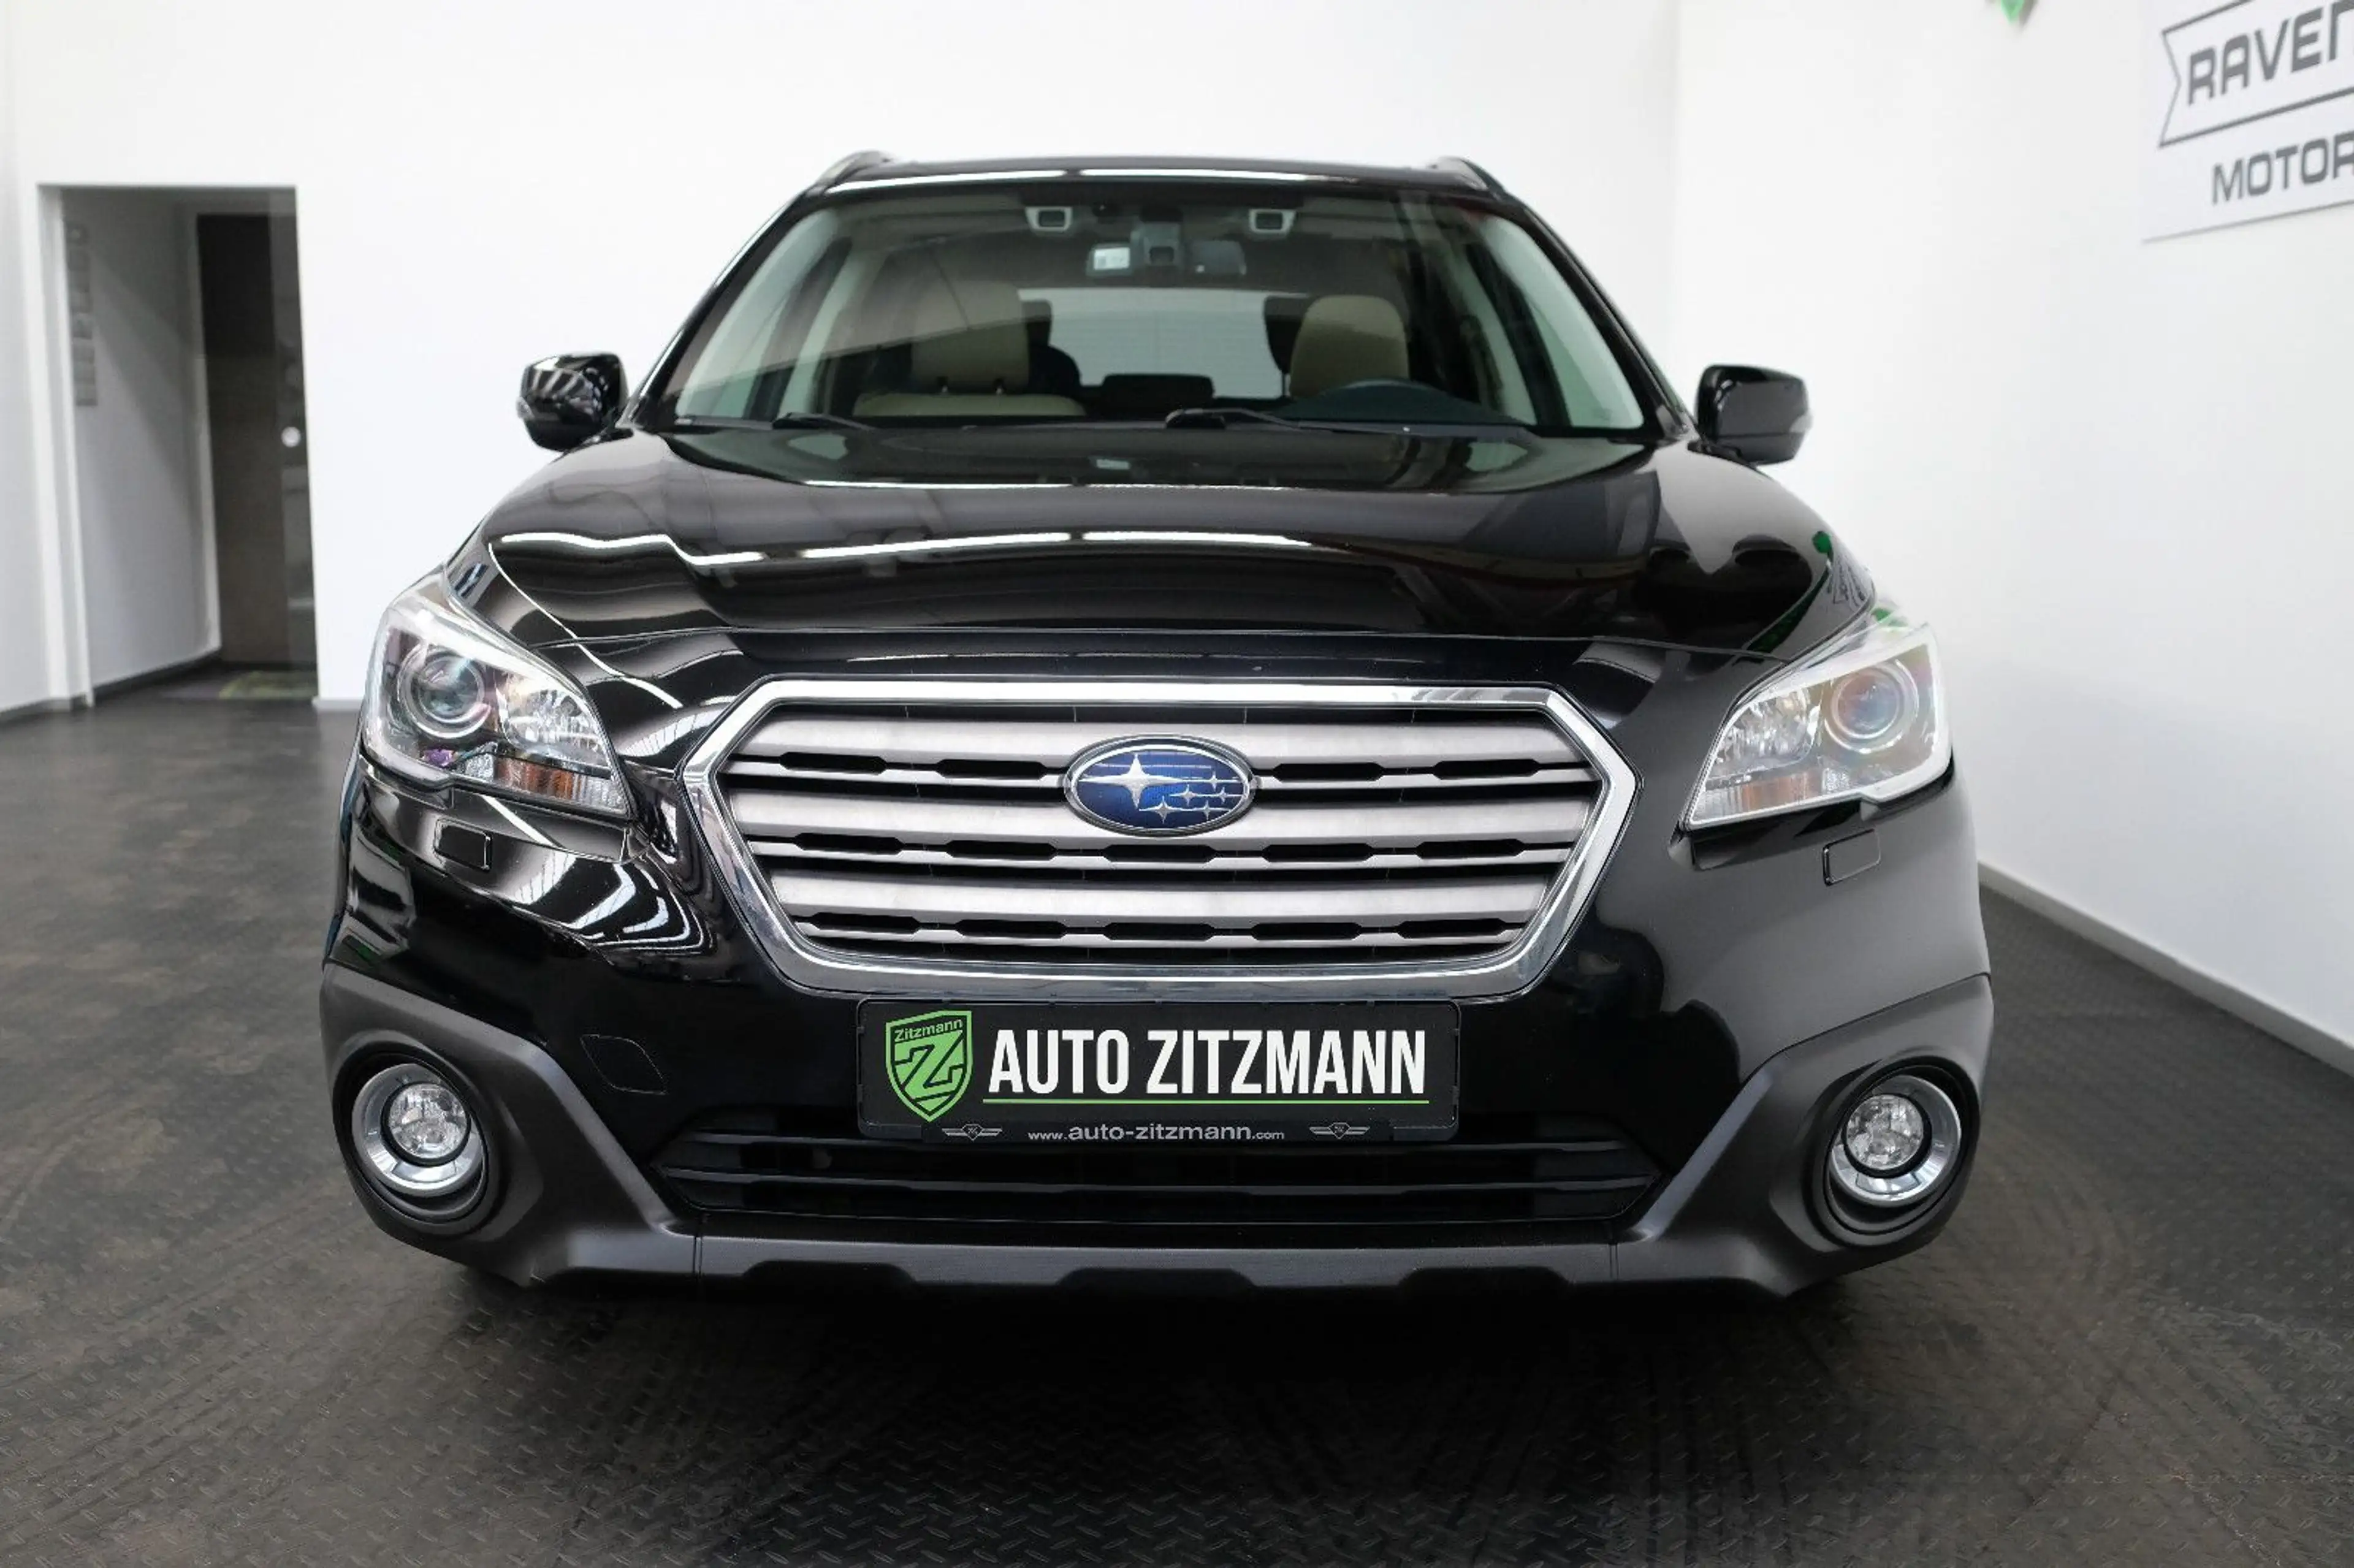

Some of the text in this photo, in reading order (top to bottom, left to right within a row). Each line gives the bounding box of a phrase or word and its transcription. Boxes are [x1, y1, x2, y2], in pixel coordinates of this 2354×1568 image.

[2212, 130, 2354, 205] MOTOR
[894, 1019, 963, 1042] Zitzmann
[988, 1029, 1425, 1094] AUTO ZITZMANN
[1027, 1123, 1285, 1141] www.auto-zitzmann.com
